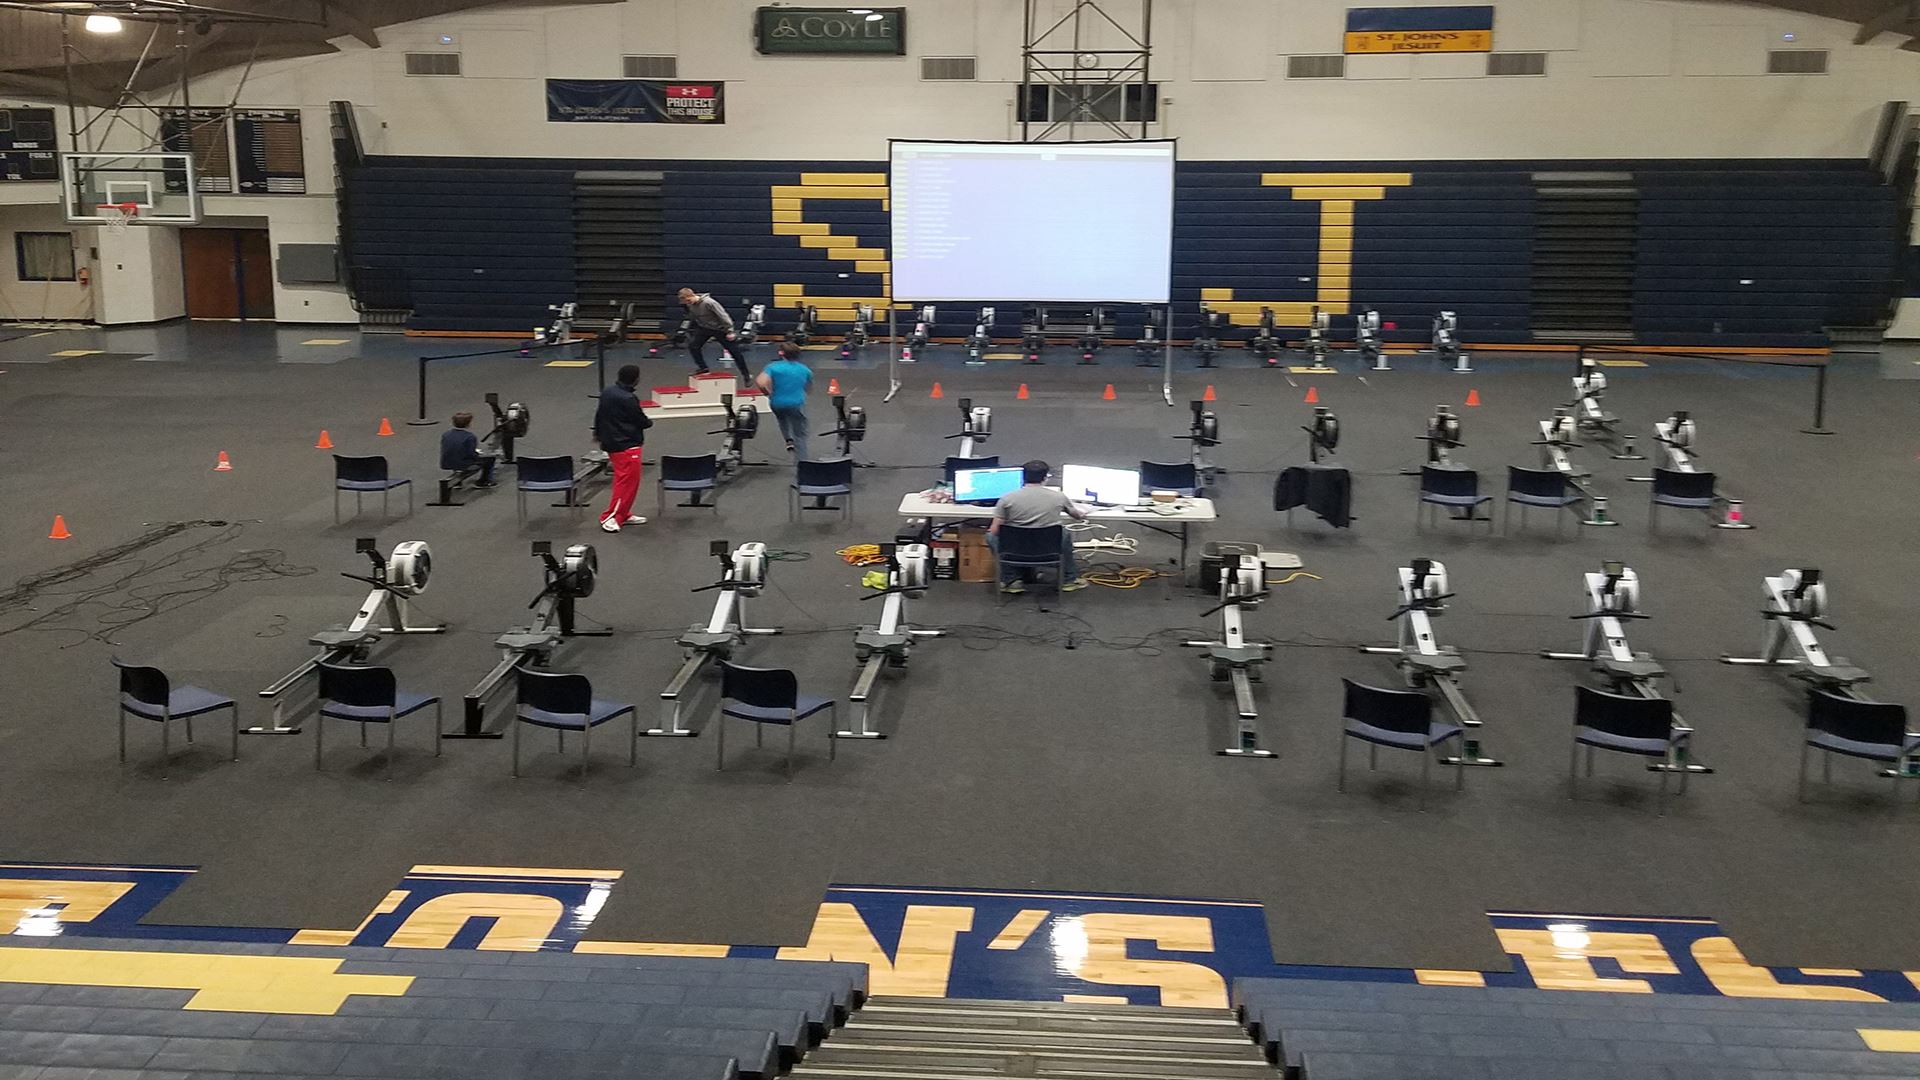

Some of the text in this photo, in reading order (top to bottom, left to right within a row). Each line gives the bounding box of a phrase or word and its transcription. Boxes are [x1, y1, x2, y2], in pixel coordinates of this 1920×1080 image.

[801, 17, 892, 38] COYLE
[666, 97, 715, 108] PROTECT
[667, 107, 715, 116] THIS HOUSE
